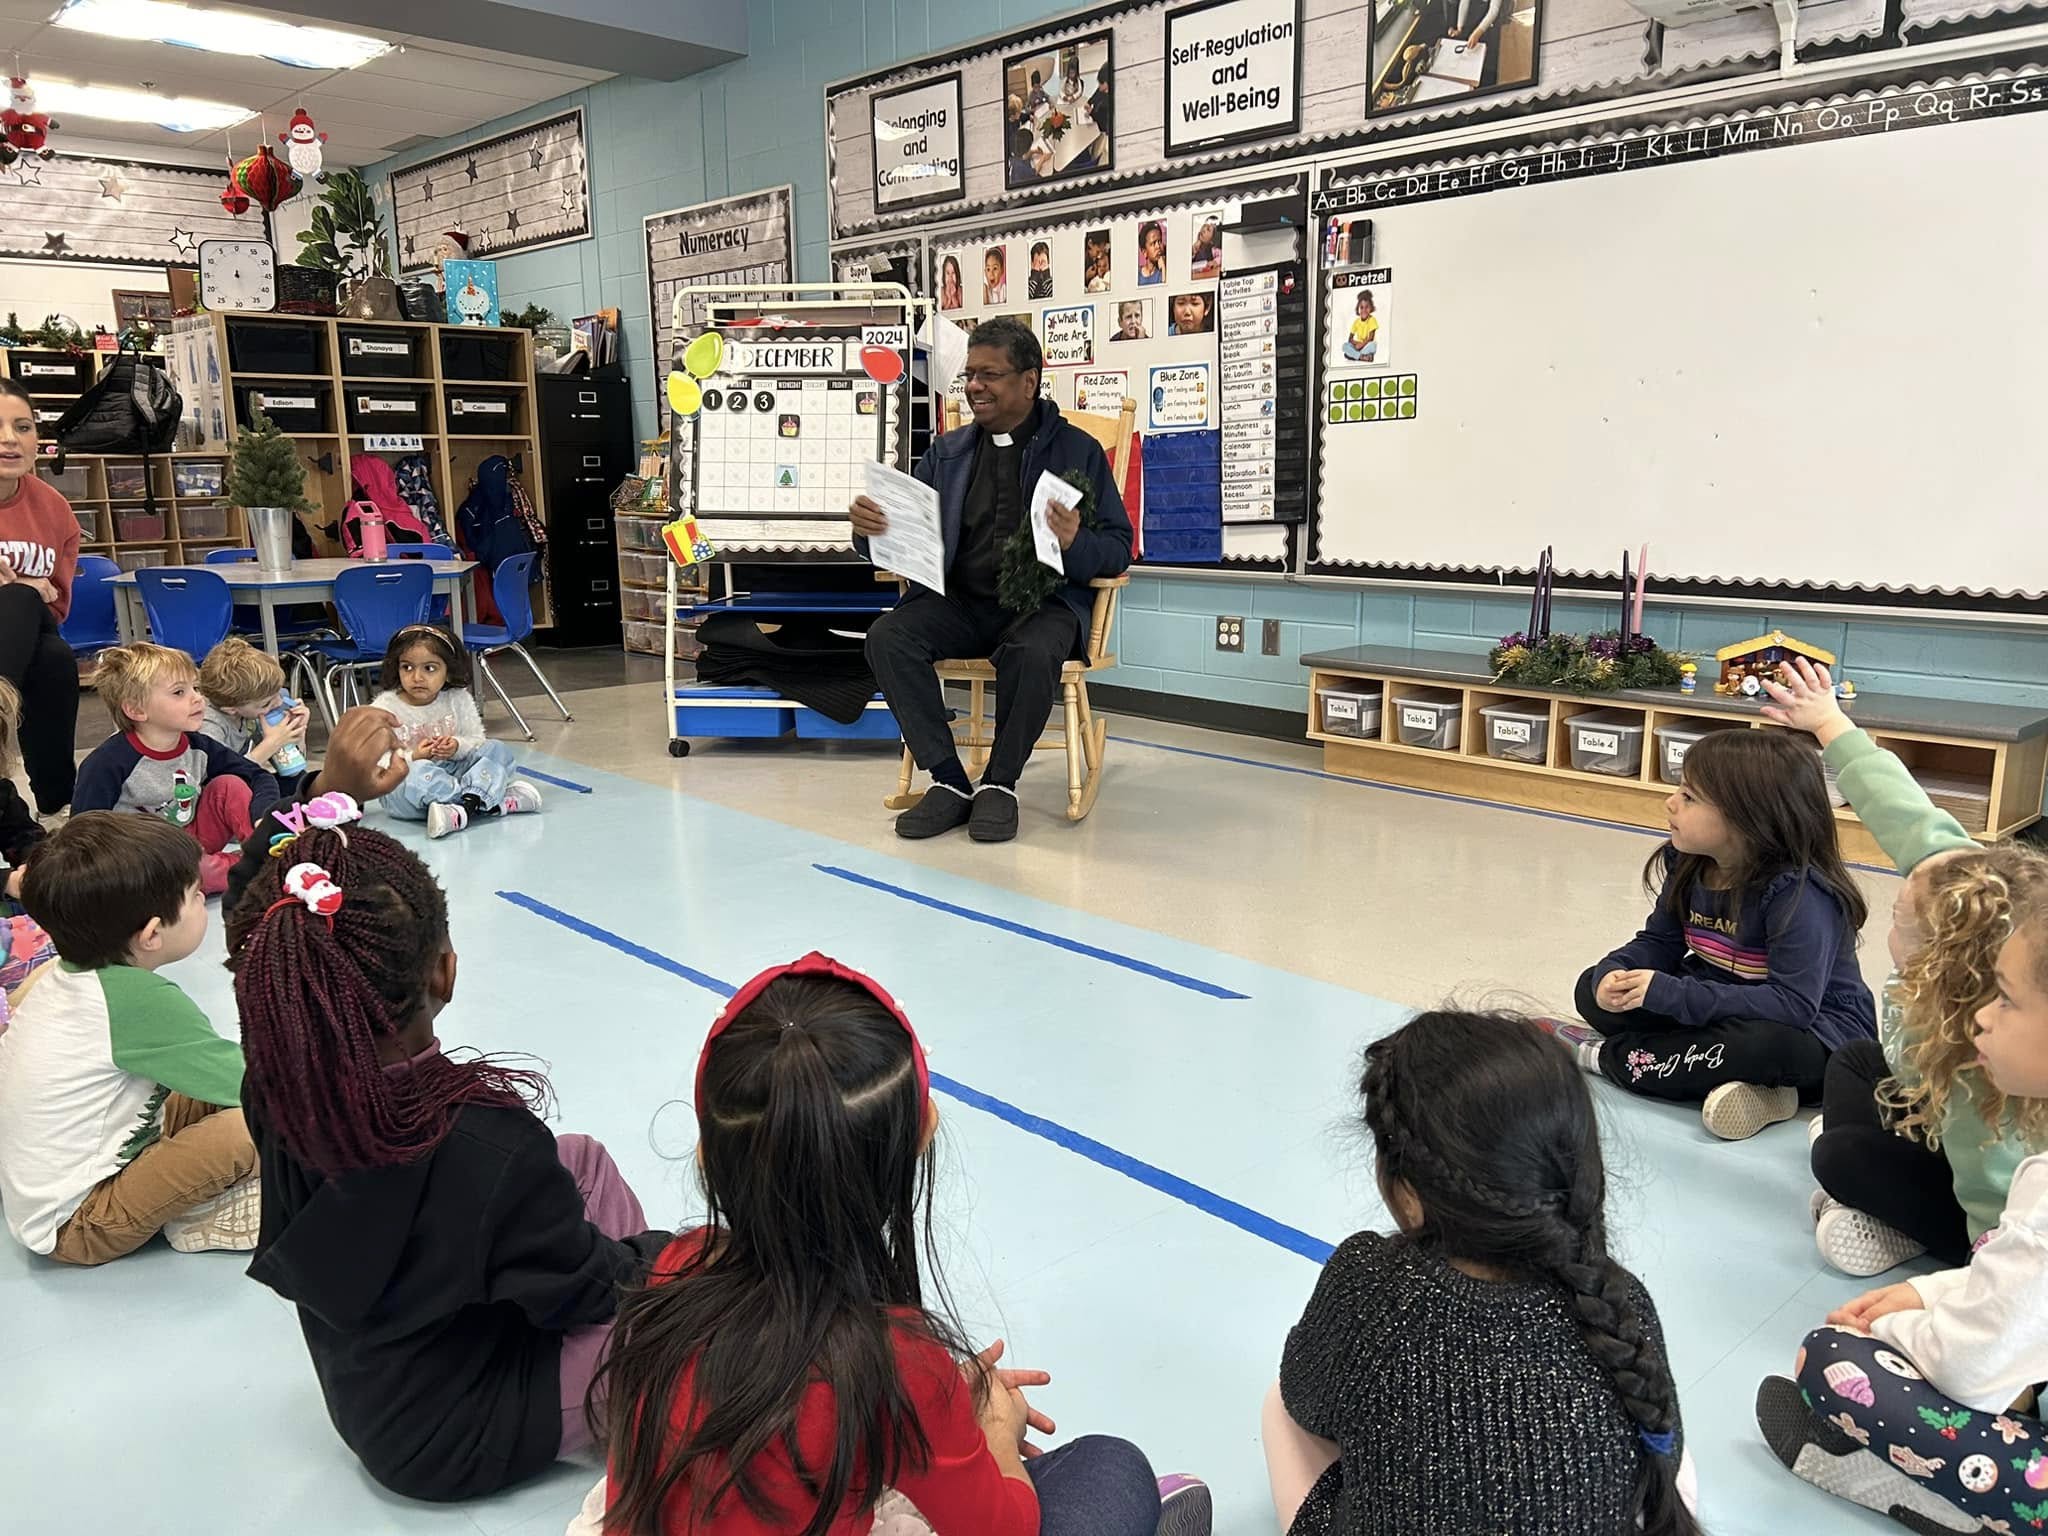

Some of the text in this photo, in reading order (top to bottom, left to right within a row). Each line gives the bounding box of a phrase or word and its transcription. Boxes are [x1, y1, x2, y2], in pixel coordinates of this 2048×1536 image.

[1172, 22, 1292, 66] Self-Regulation
[1211, 57, 1248, 86] and
[1182, 86, 1280, 122] Well-Being
[903, 135, 928, 156] and
[1315, 80, 2042, 209] Aa Bb Cc Dd Ee Ff Gg Hh Ii Jj Kk Ll Mm Nn Oo Pp Qq Rr Ss
[679, 226, 748, 255] Numeracy
[1223, 278, 1254, 289] Table Top
[1348, 269, 1387, 287] Pretzel
[1223, 300, 1247, 309] Literacy
[1057, 312, 1078, 324] What
[1223, 320, 1256, 330] Washroom
[865, 331, 903, 345] 2024
[1048, 329, 1088, 343] Zone Are
[1223, 342, 1248, 351] Nutrition
[1052, 346, 1083, 360] You in?
[1223, 364, 1237, 372] Gym
[1084, 375, 1118, 386] Red Zone
[1160, 370, 1200, 382] Blue Zone
[948, 384, 965, 394] Gree
[1223, 383, 1255, 391] Numeracy
[709, 394, 716, 407] 1
[732, 395, 742, 409] 2
[759, 394, 769, 409] 3
[1223, 403, 1241, 411] Lunch
[1224, 422, 1259, 431] Mindfulness
[1224, 470, 1257, 478] Exploration
[1330, 704, 1348, 713] Table
[1407, 714, 1433, 725] Table 2
[1497, 726, 1526, 737] Table 3
[1582, 737, 1614, 748] Table 4
[1642, 1043, 1725, 1079] Body Glove
